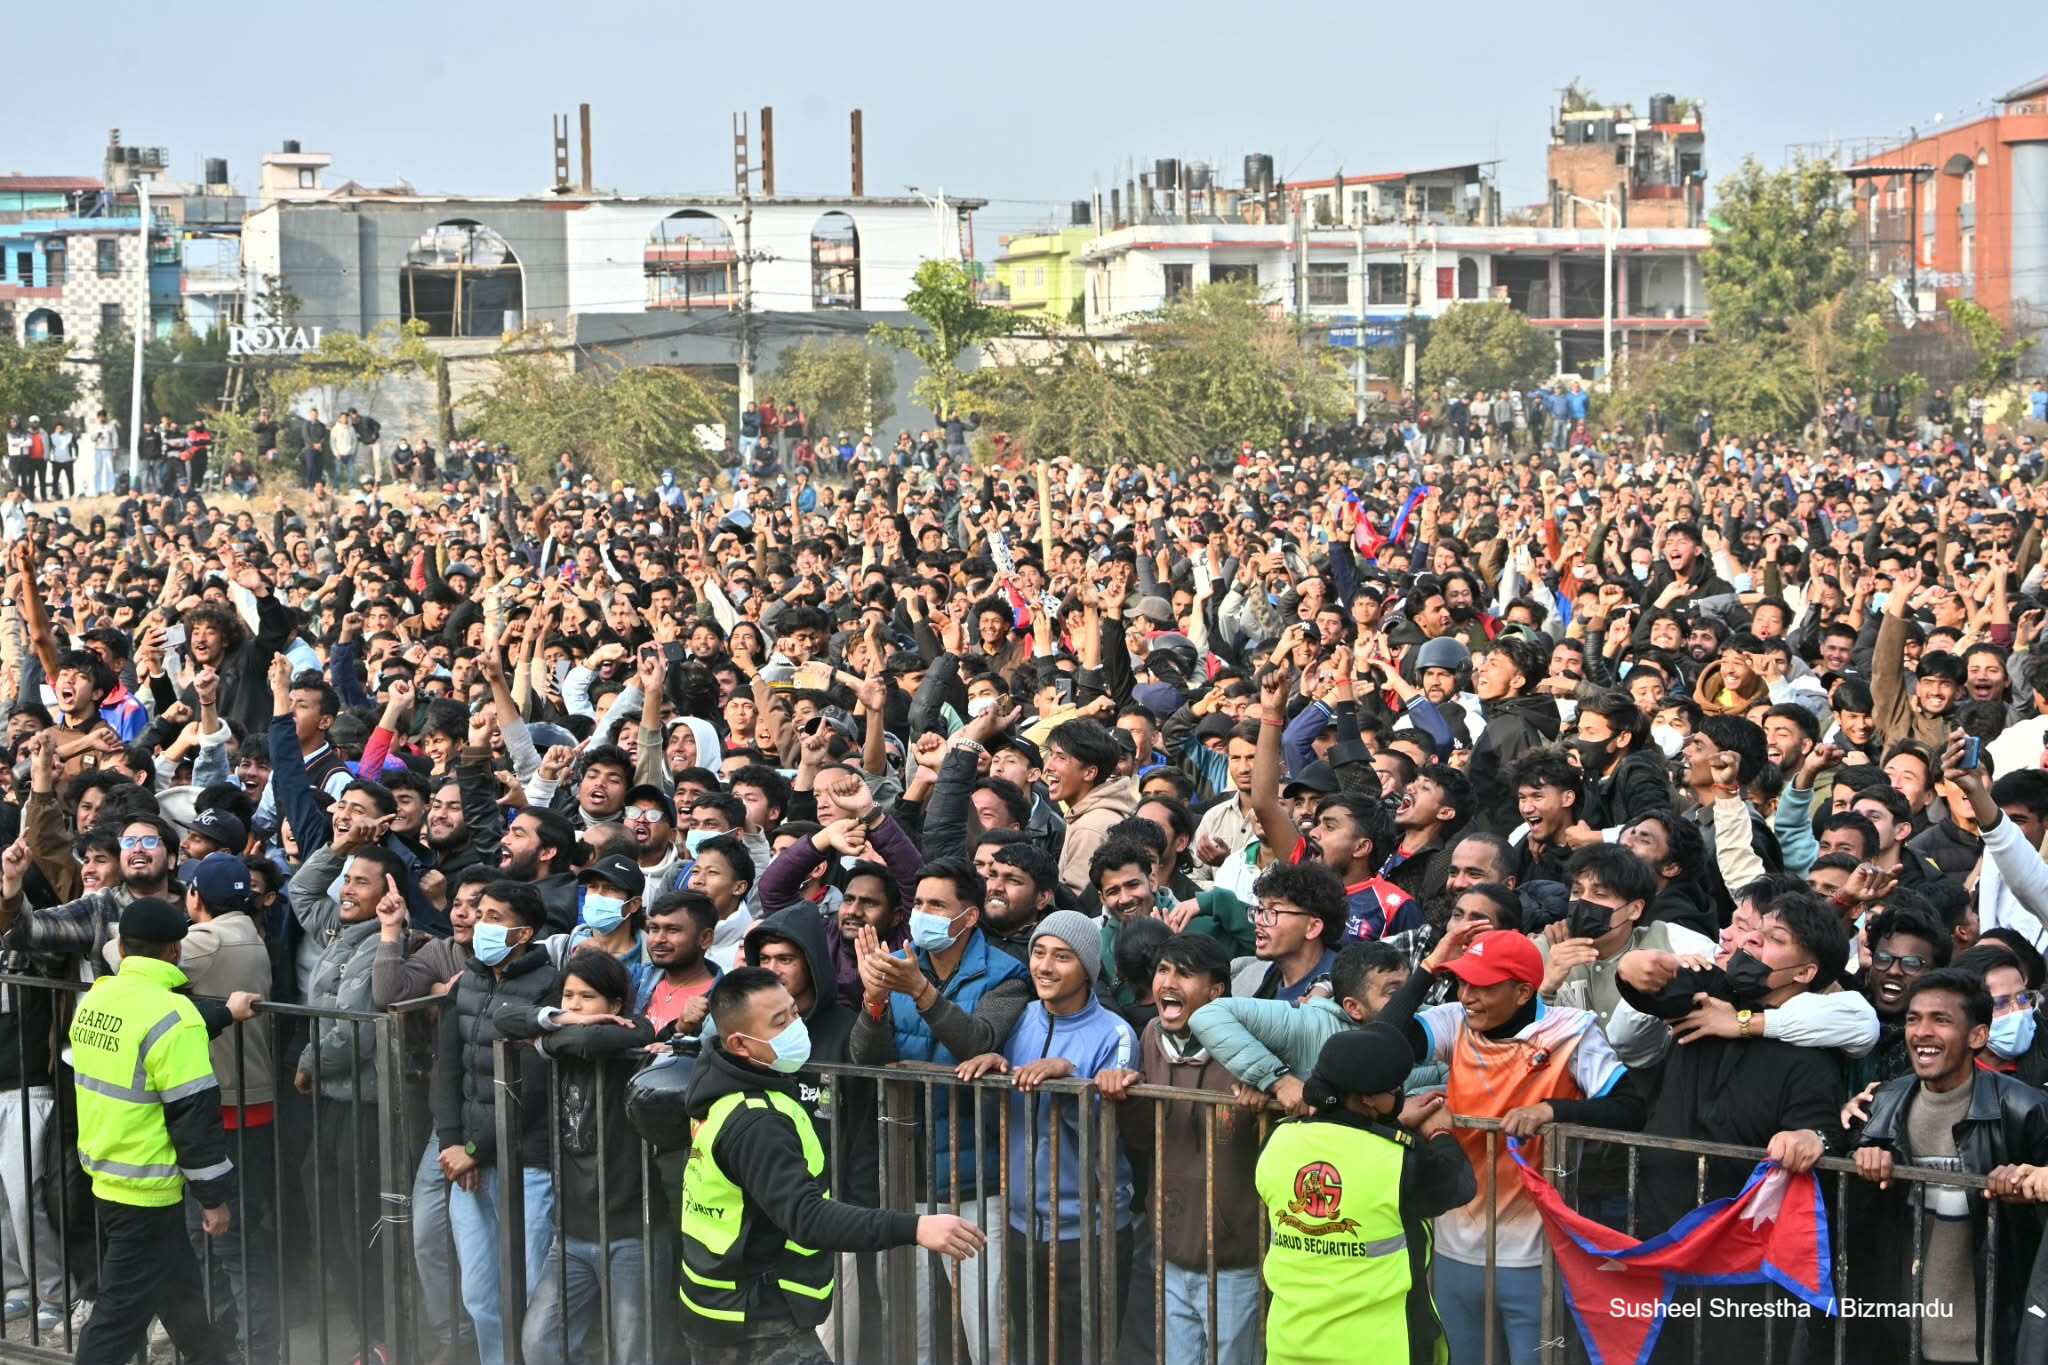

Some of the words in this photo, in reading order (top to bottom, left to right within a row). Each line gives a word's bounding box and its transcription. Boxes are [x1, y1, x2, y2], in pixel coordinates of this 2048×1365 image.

[77, 1008, 123, 1034] GARUD
[72, 1026, 120, 1053] SECURITIES
[1304, 1237, 1366, 1257] SECURITIES
